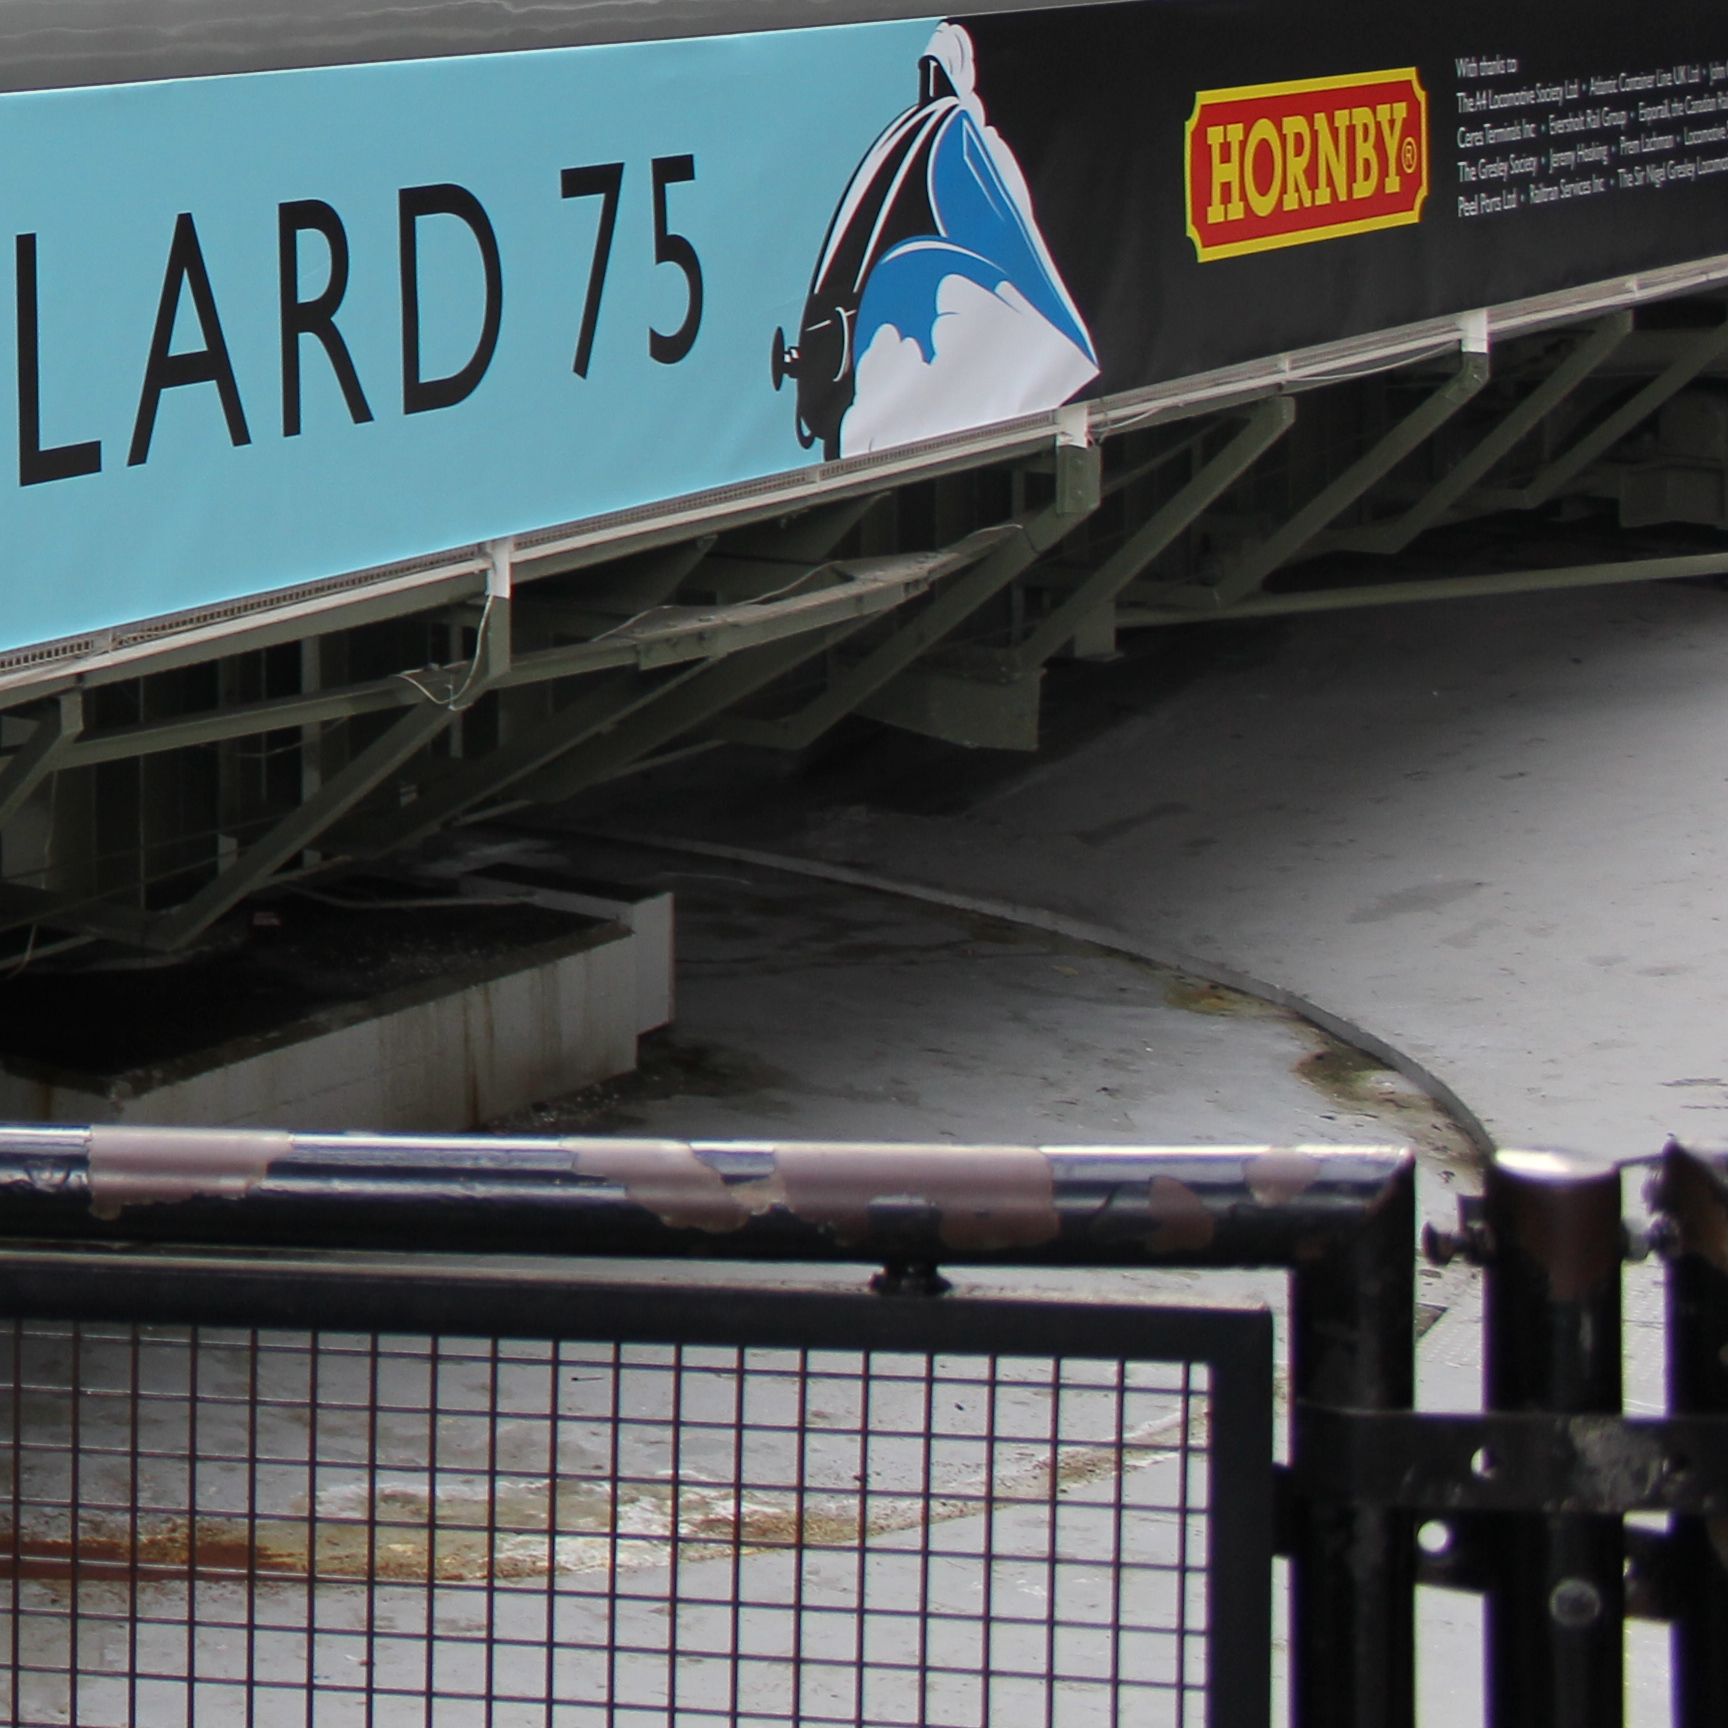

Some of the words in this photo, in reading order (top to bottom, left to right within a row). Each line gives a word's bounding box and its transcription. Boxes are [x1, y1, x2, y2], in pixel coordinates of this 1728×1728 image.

[1454, 56, 1479, 78] With
[1479, 54, 1506, 77] thanks
[1456, 92, 1475, 113] The
[1488, 85, 1536, 110] Locomotive
[1535, 82, 1564, 106] Society
[1457, 161, 1478, 182] The
[1509, 153, 1538, 176] Society
[560, 153, 704, 380] 75
